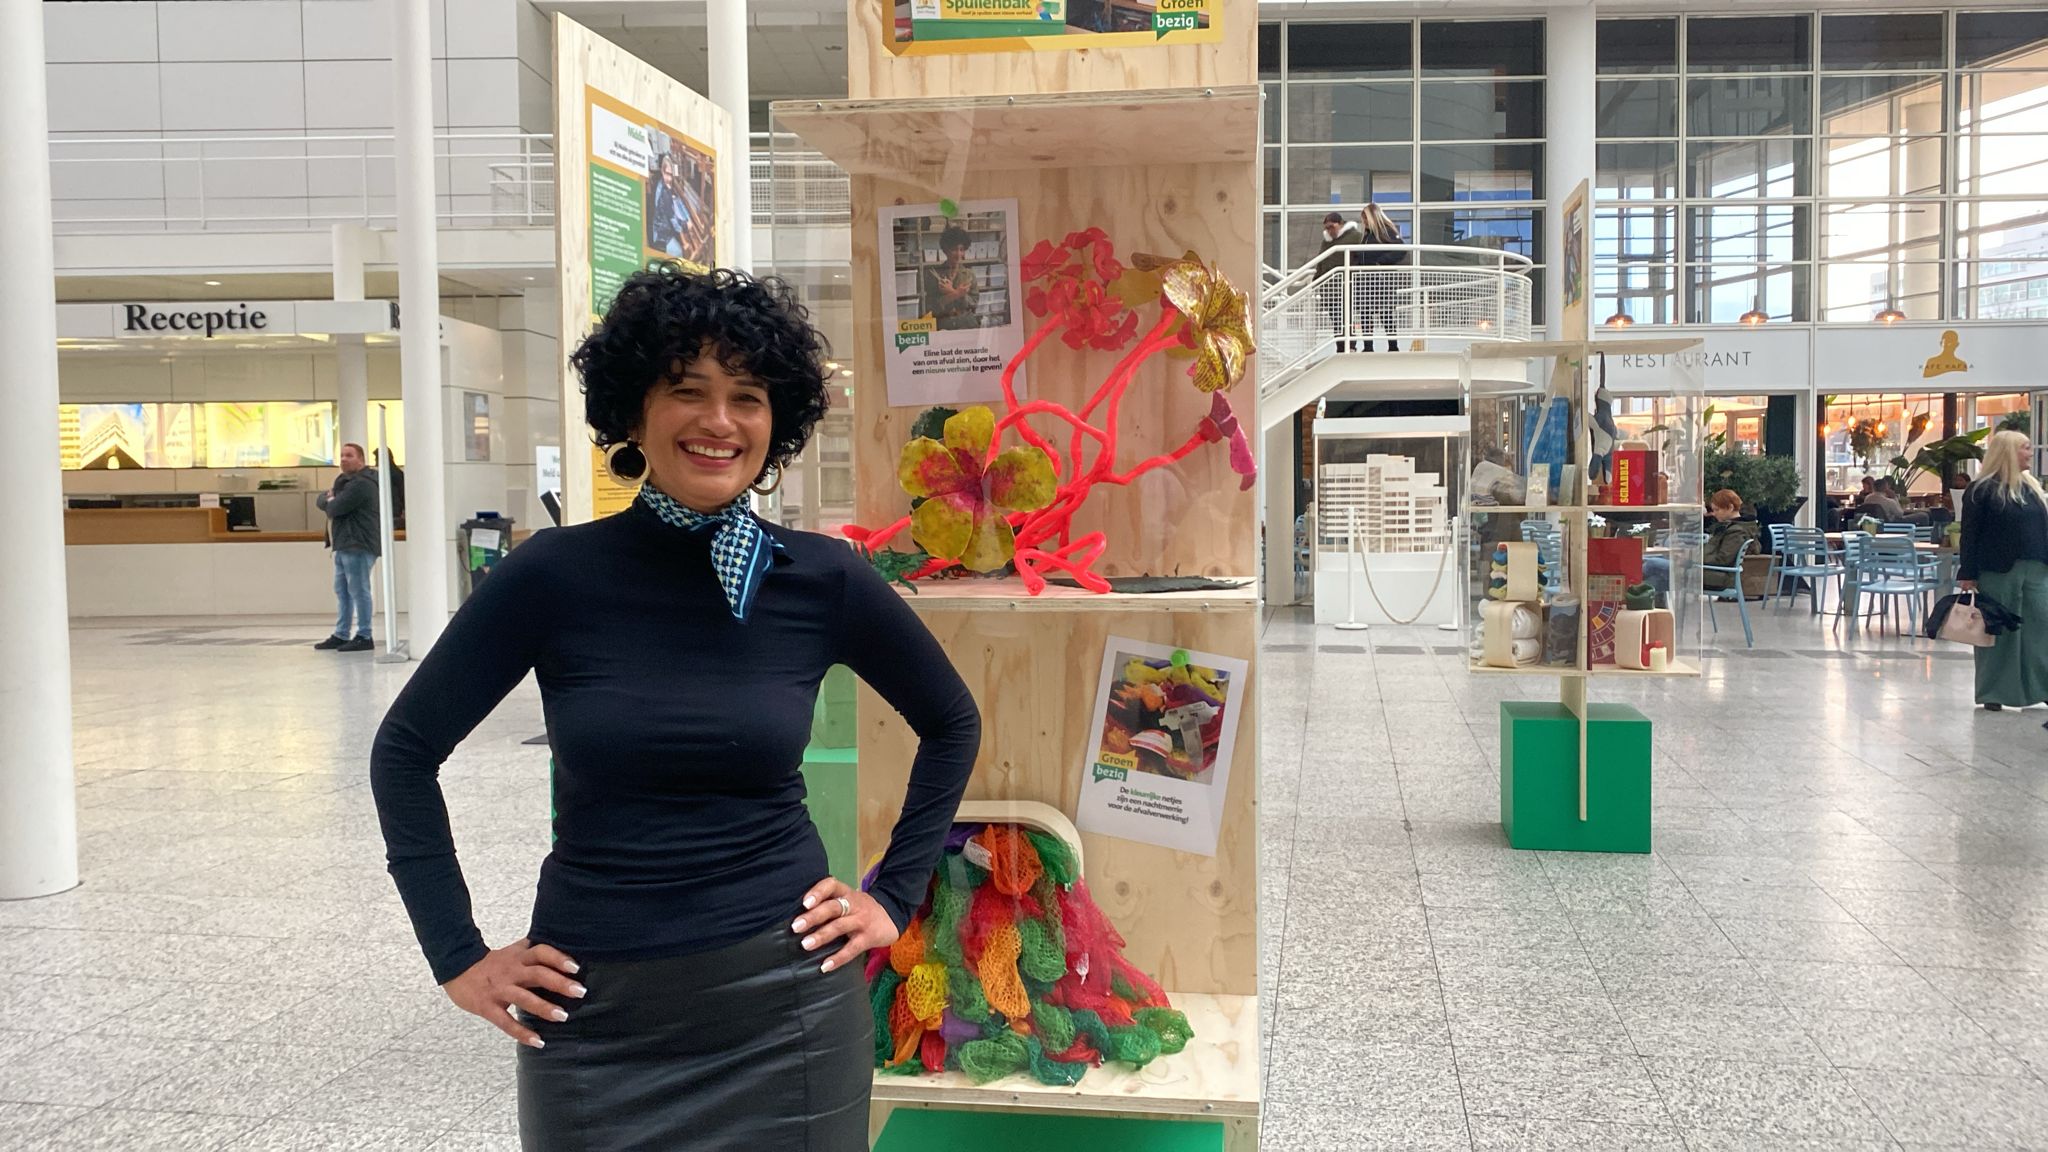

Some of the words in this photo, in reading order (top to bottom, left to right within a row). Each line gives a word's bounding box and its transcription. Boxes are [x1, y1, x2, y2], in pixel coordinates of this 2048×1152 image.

[1161, 0, 1203, 9] Groen
[1156, 14, 1194, 30] bezig
[124, 303, 267, 337] Receptie
[901, 321, 932, 331] Groen
[898, 334, 926, 345] bezig
[1623, 351, 1752, 368] RESTAURANT
[980, 364, 1002, 372] geven!
[1620, 459, 1629, 503] SCRABBLE
[1101, 753, 1133, 767] Groen
[1096, 766, 1125, 780] bezig
[1120, 786, 1129, 794] De
[1162, 796, 1182, 805] netjes
[1117, 795, 1128, 804] zijn
[1142, 799, 1183, 814] nachtmerrie
[1108, 802, 1123, 810] voor
[1133, 806, 1188, 824] afvalverwerking!
